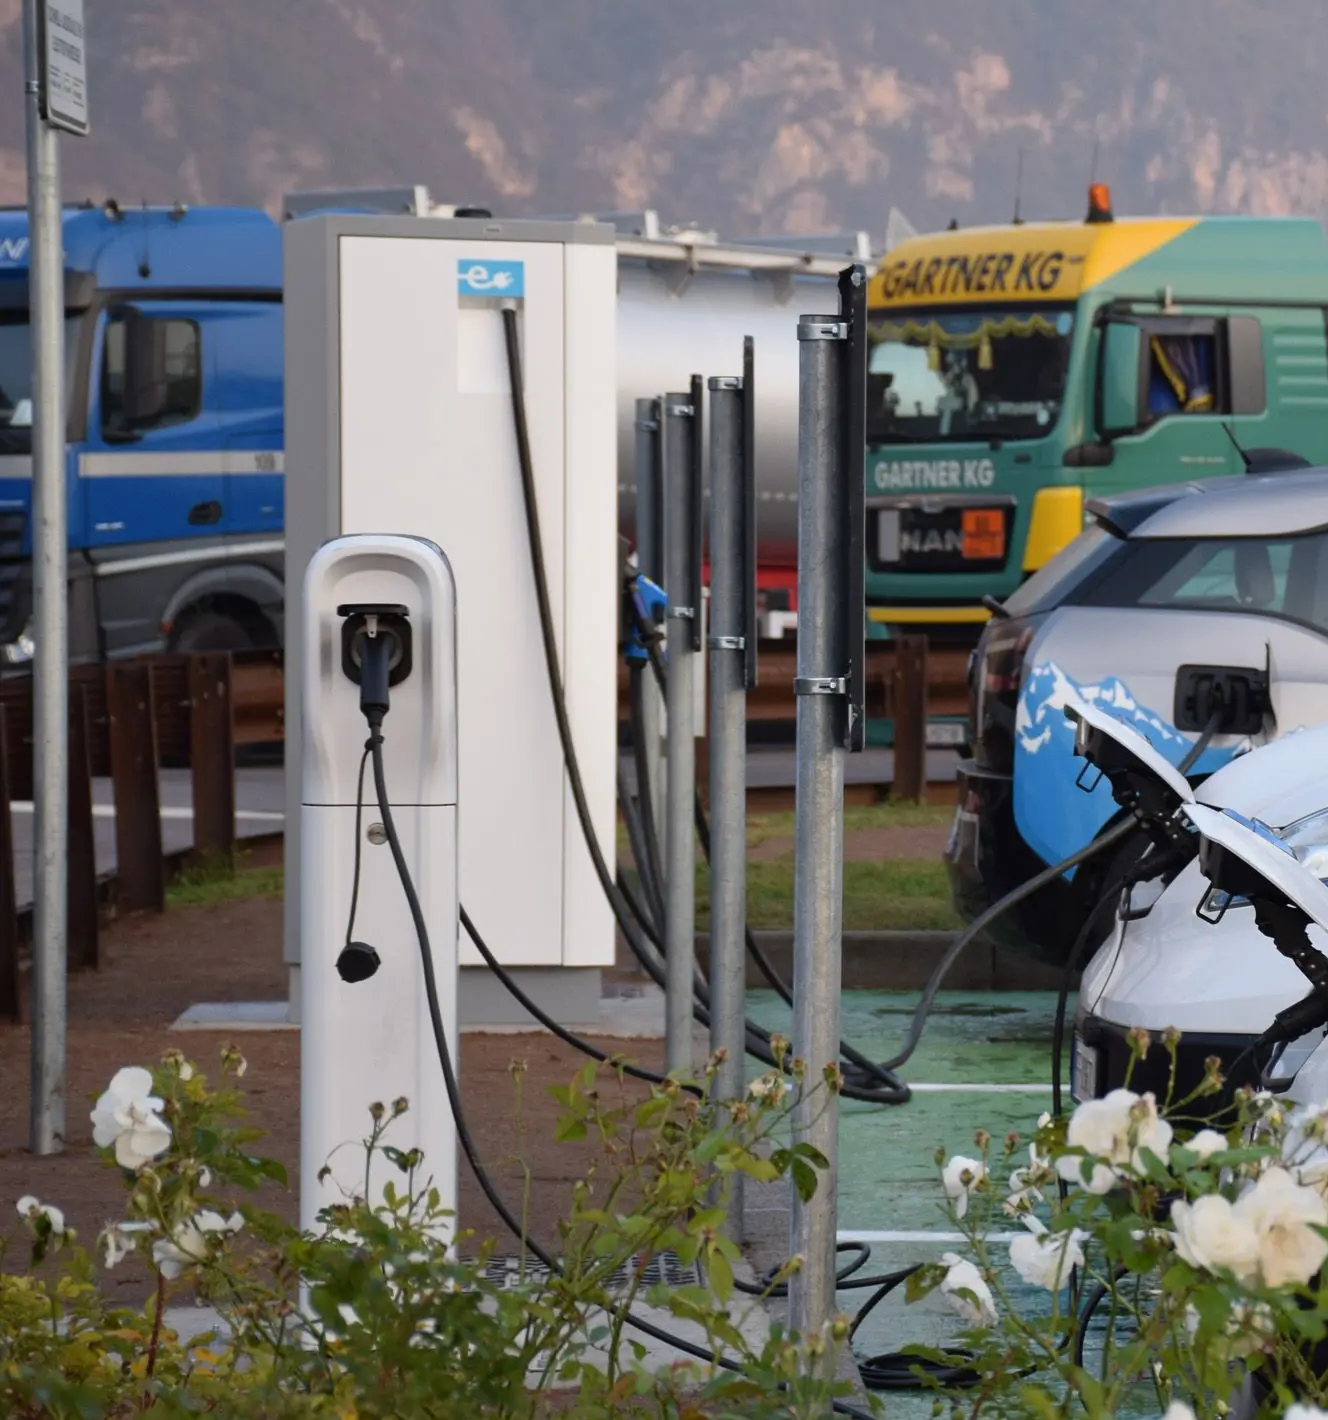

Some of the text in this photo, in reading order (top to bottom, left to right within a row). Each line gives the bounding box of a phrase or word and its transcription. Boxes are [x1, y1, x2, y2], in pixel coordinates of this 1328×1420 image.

[881, 249, 1064, 300] GARTNER KG
[874, 458, 995, 489] GARTNER KG
